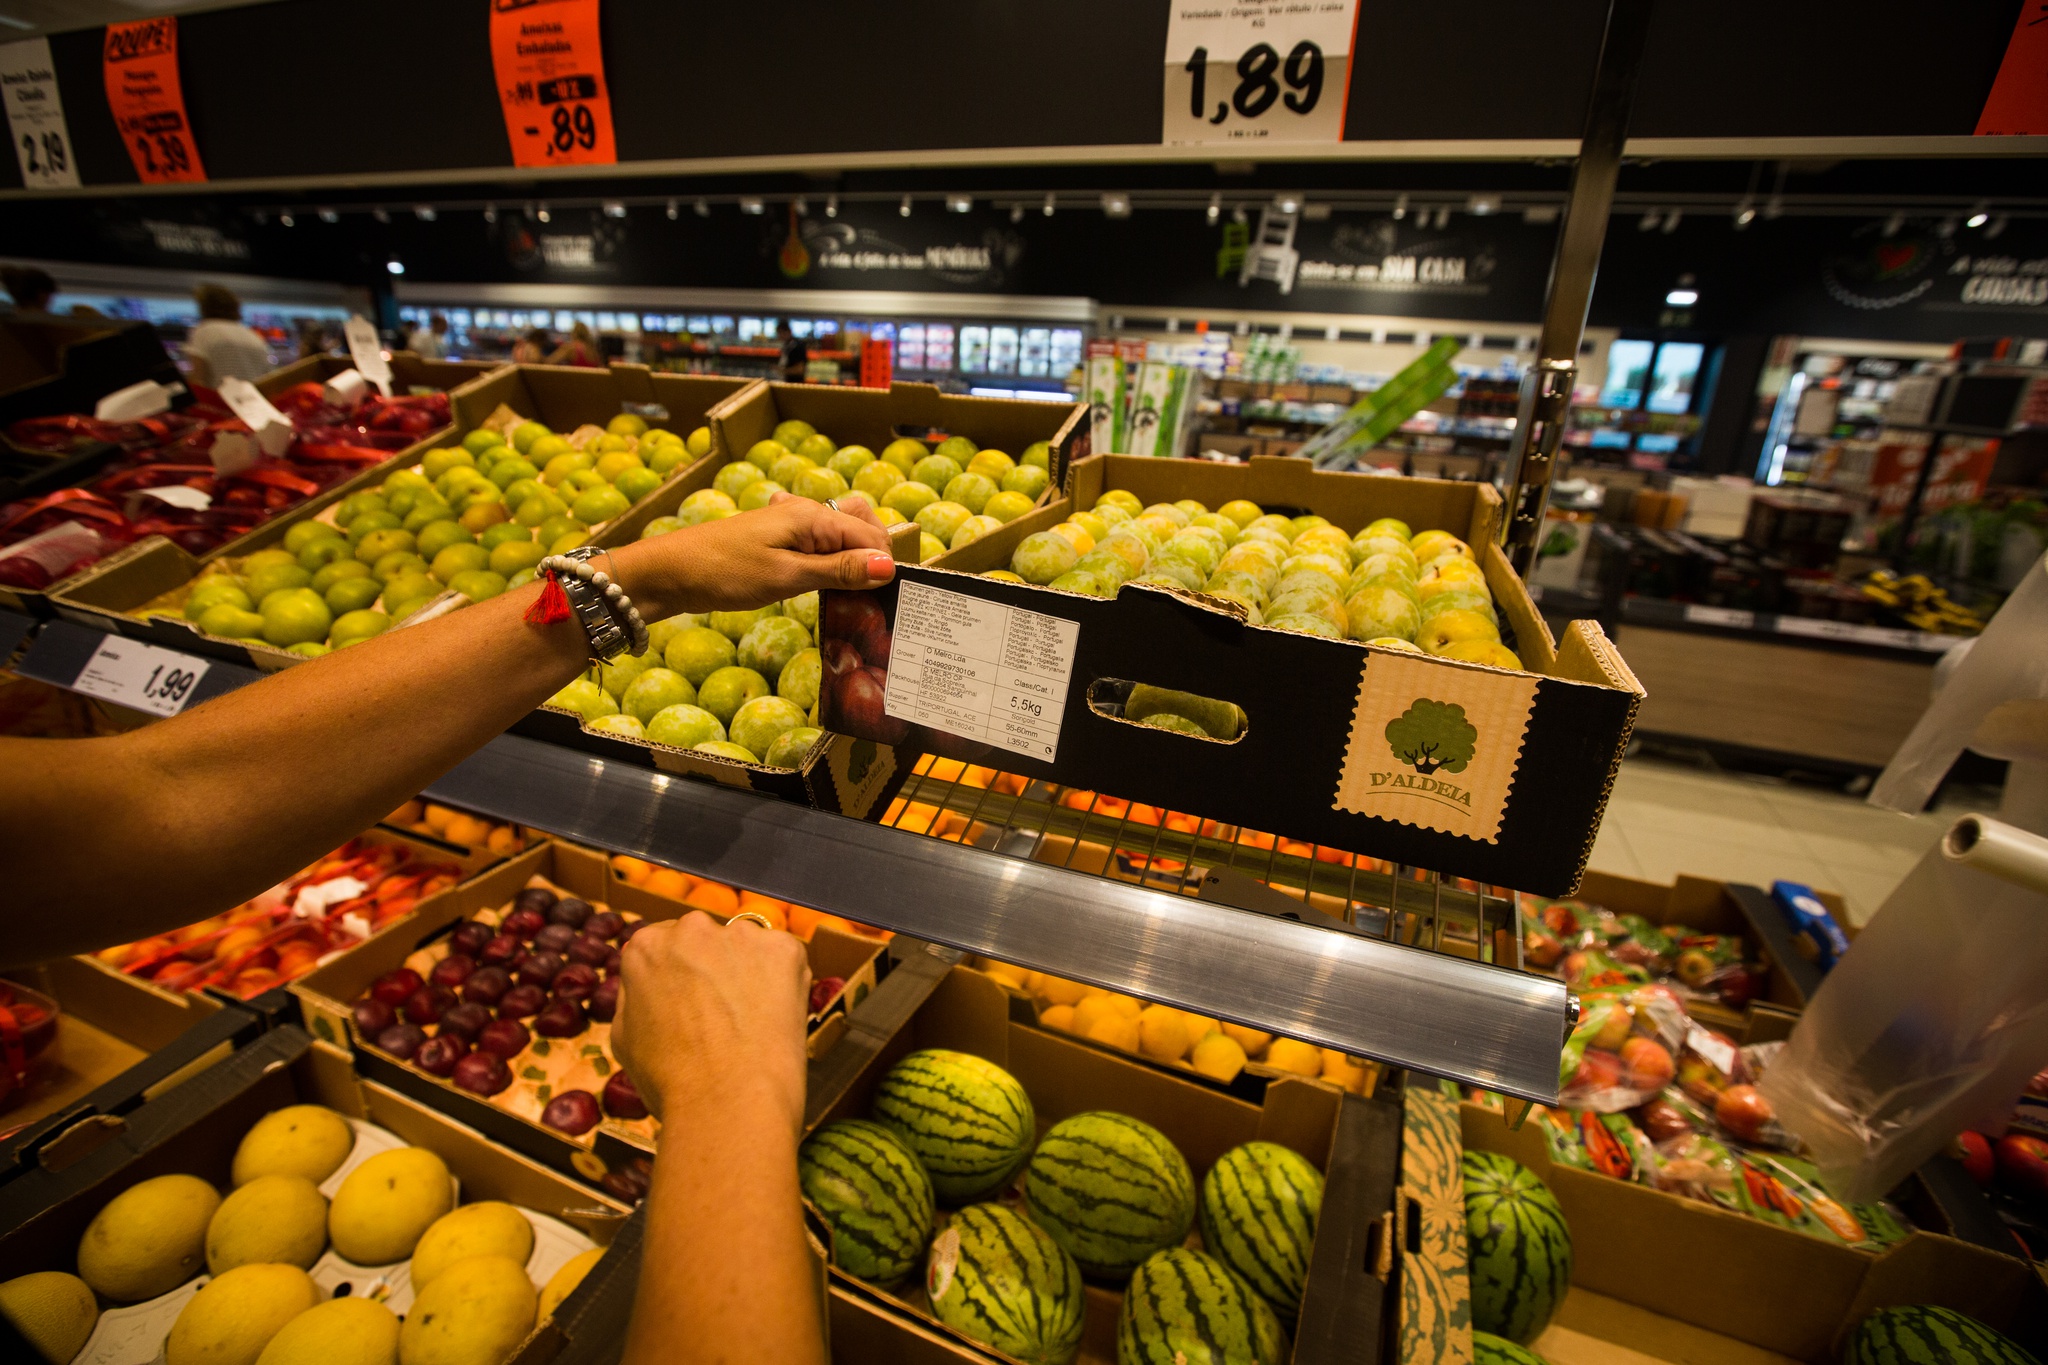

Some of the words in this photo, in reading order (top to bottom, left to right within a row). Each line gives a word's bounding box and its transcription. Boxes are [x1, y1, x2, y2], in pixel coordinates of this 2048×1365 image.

[1181, 10, 1222, 20] Variedade
[1231, 7, 1264, 19] Origem:
[1269, 5, 1283, 15] Ver
[1252, 18, 1265, 28] KG
[1185, 39, 1325, 125] 1,89
[22, 131, 67, 177] 2,19
[934, 602, 951, 610] Ameixa
[1012, 609, 1032, 619] Portugal
[1036, 615, 1056, 625] Portugal
[1011, 615, 1031, 625] Portugal
[1036, 621, 1057, 632] Portugal
[1040, 628, 1060, 638] Portugal
[1008, 638, 1027, 648] Portugal
[1043, 635, 1063, 645] Portugal
[896, 648, 916, 659] Grower
[1006, 649, 1025, 659] Portugal
[891, 672, 920, 686] Packhouse
[922, 672, 933, 680] Rua
[930, 668, 952, 679] MELRO
[143, 663, 195, 702] 1,99
[889, 691, 908, 702] Supplier
[887, 702, 897, 711] Key
[1010, 695, 1043, 717] 5,5kg
[1005, 723, 1038, 739] 55-60mm
[1007, 736, 1030, 749] L3502
